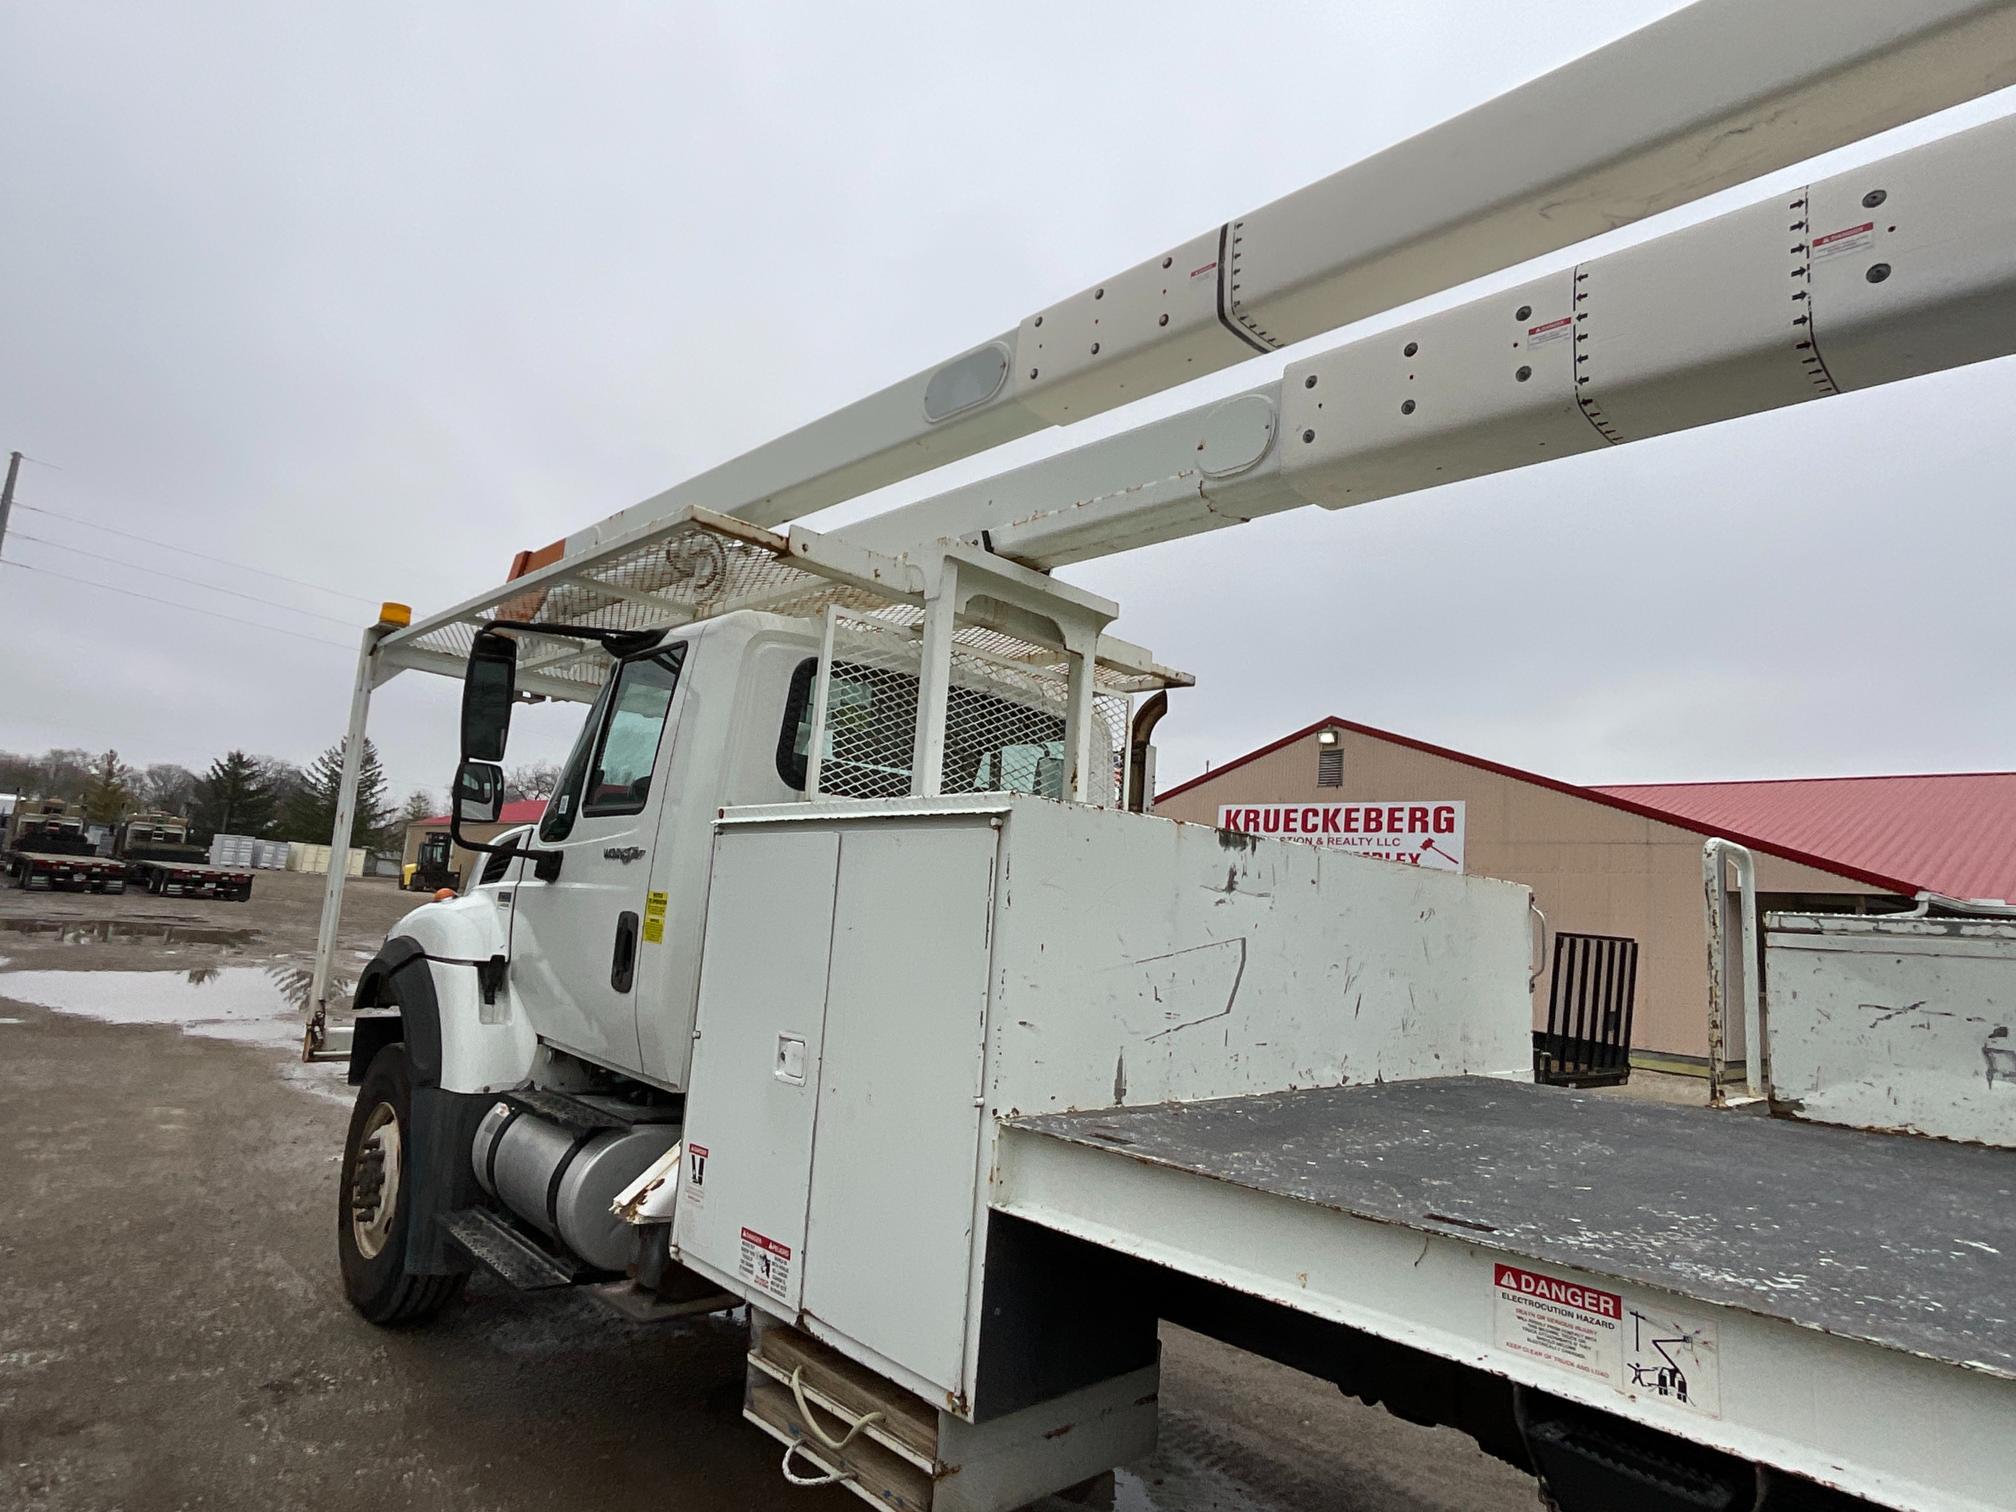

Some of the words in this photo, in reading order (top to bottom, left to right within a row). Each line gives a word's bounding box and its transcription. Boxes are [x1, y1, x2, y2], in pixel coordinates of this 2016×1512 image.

[1225, 806, 1455, 833] KRUECKEBERG
[1316, 837, 1323, 845] &
[1327, 837, 1372, 846] REALTY
[1377, 837, 1400, 847] LLC
[1502, 1292, 1574, 1318] ELECTROCUTION
[1577, 1313, 1615, 1330] HAZARD
[1520, 1274, 1615, 1317] DANGER
